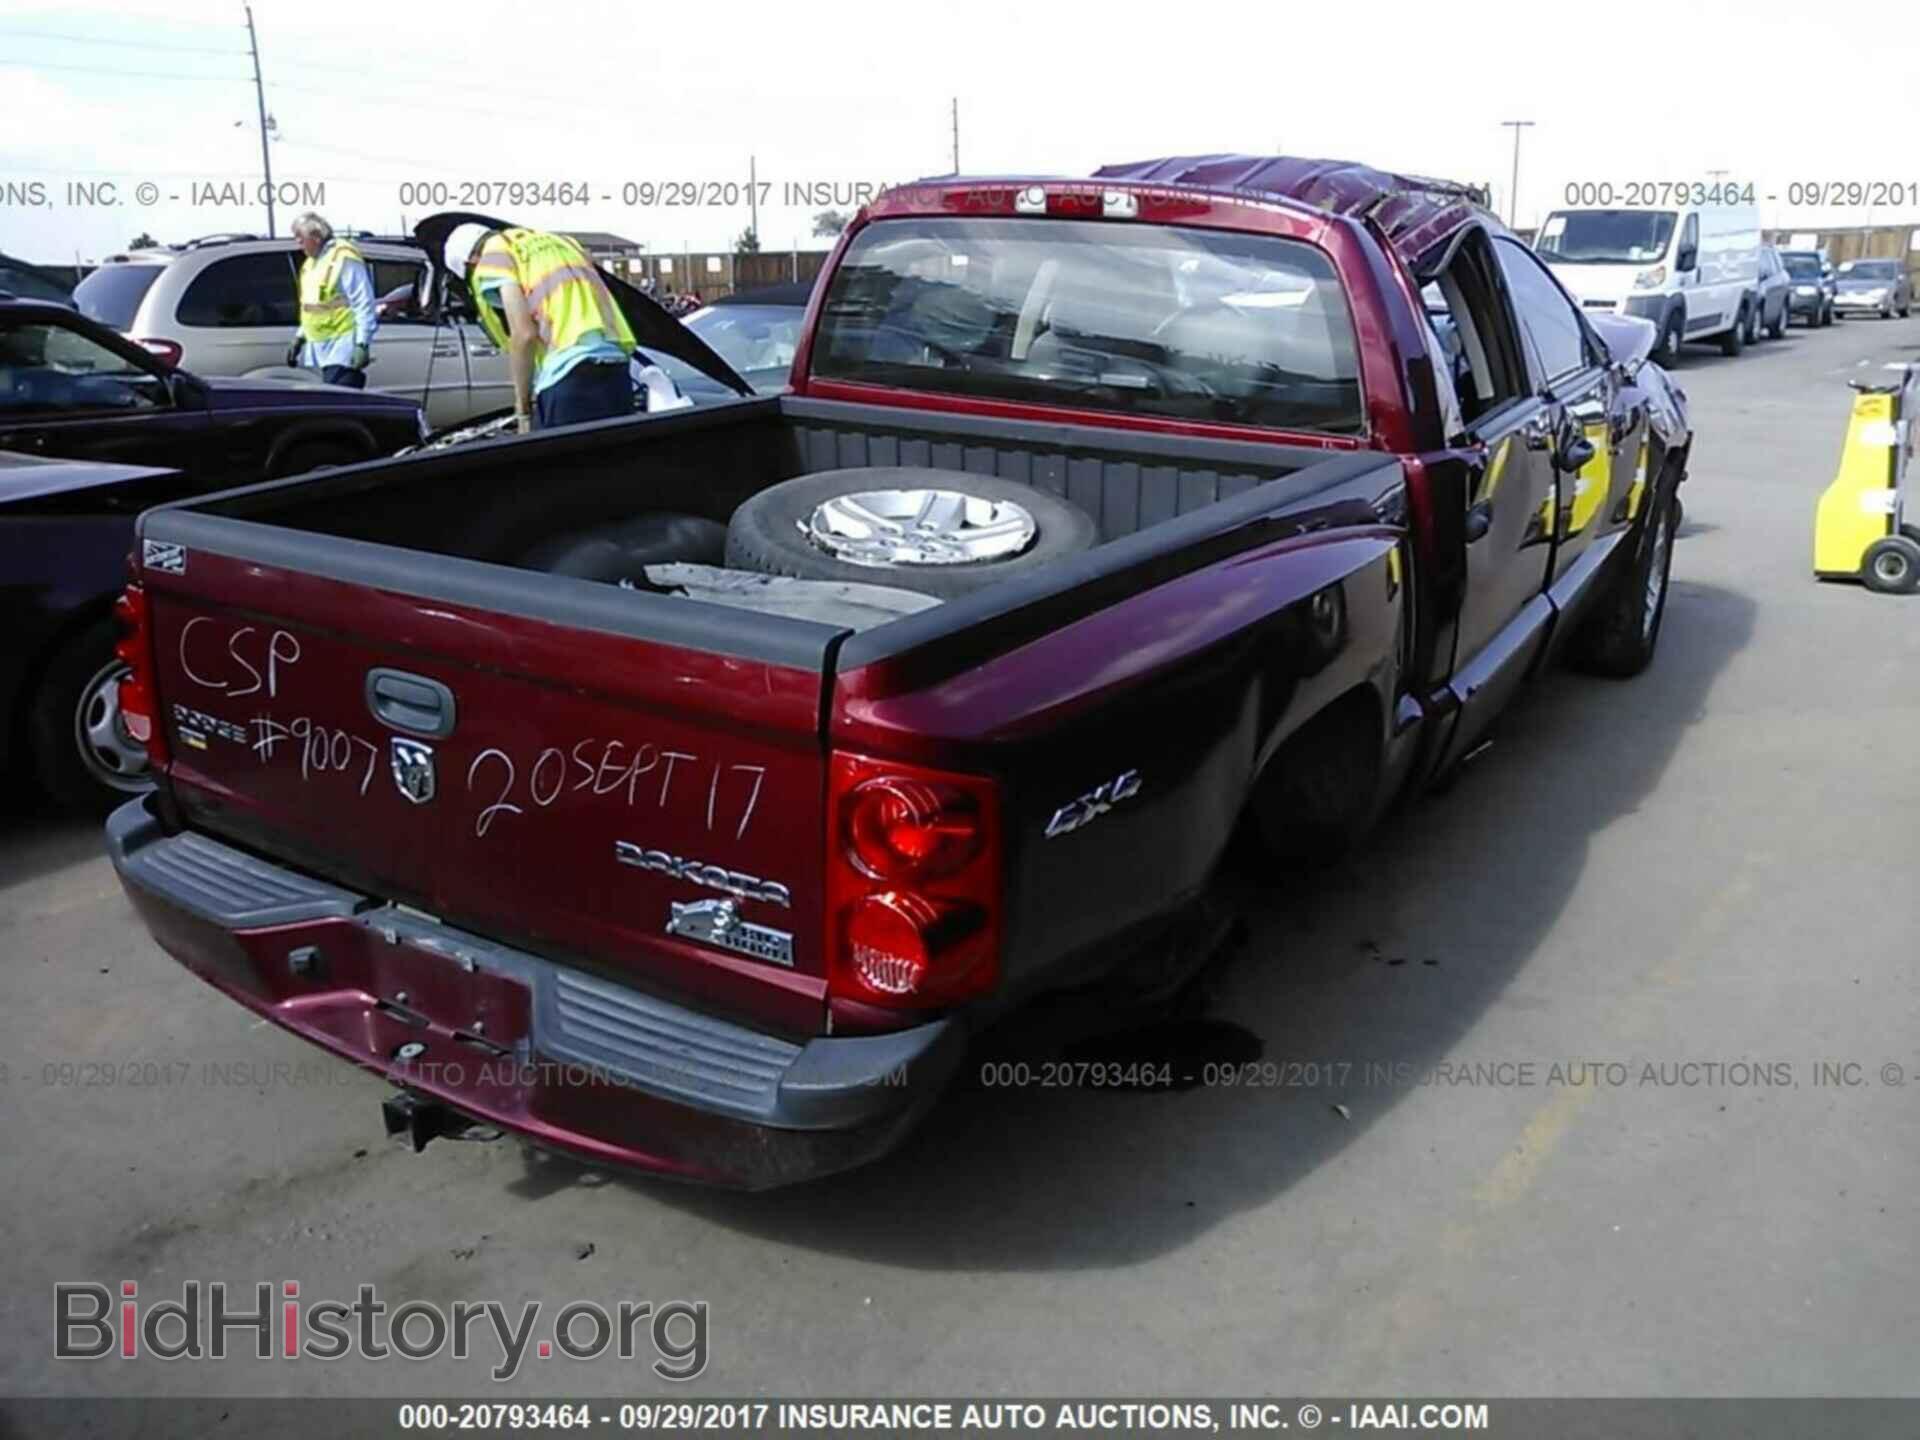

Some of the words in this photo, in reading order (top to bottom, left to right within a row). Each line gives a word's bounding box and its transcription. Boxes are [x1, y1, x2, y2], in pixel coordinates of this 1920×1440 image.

[179, 616, 301, 698] CSP
[250, 711, 379, 797] #9007
[614, 838, 792, 910] DAKOTA
